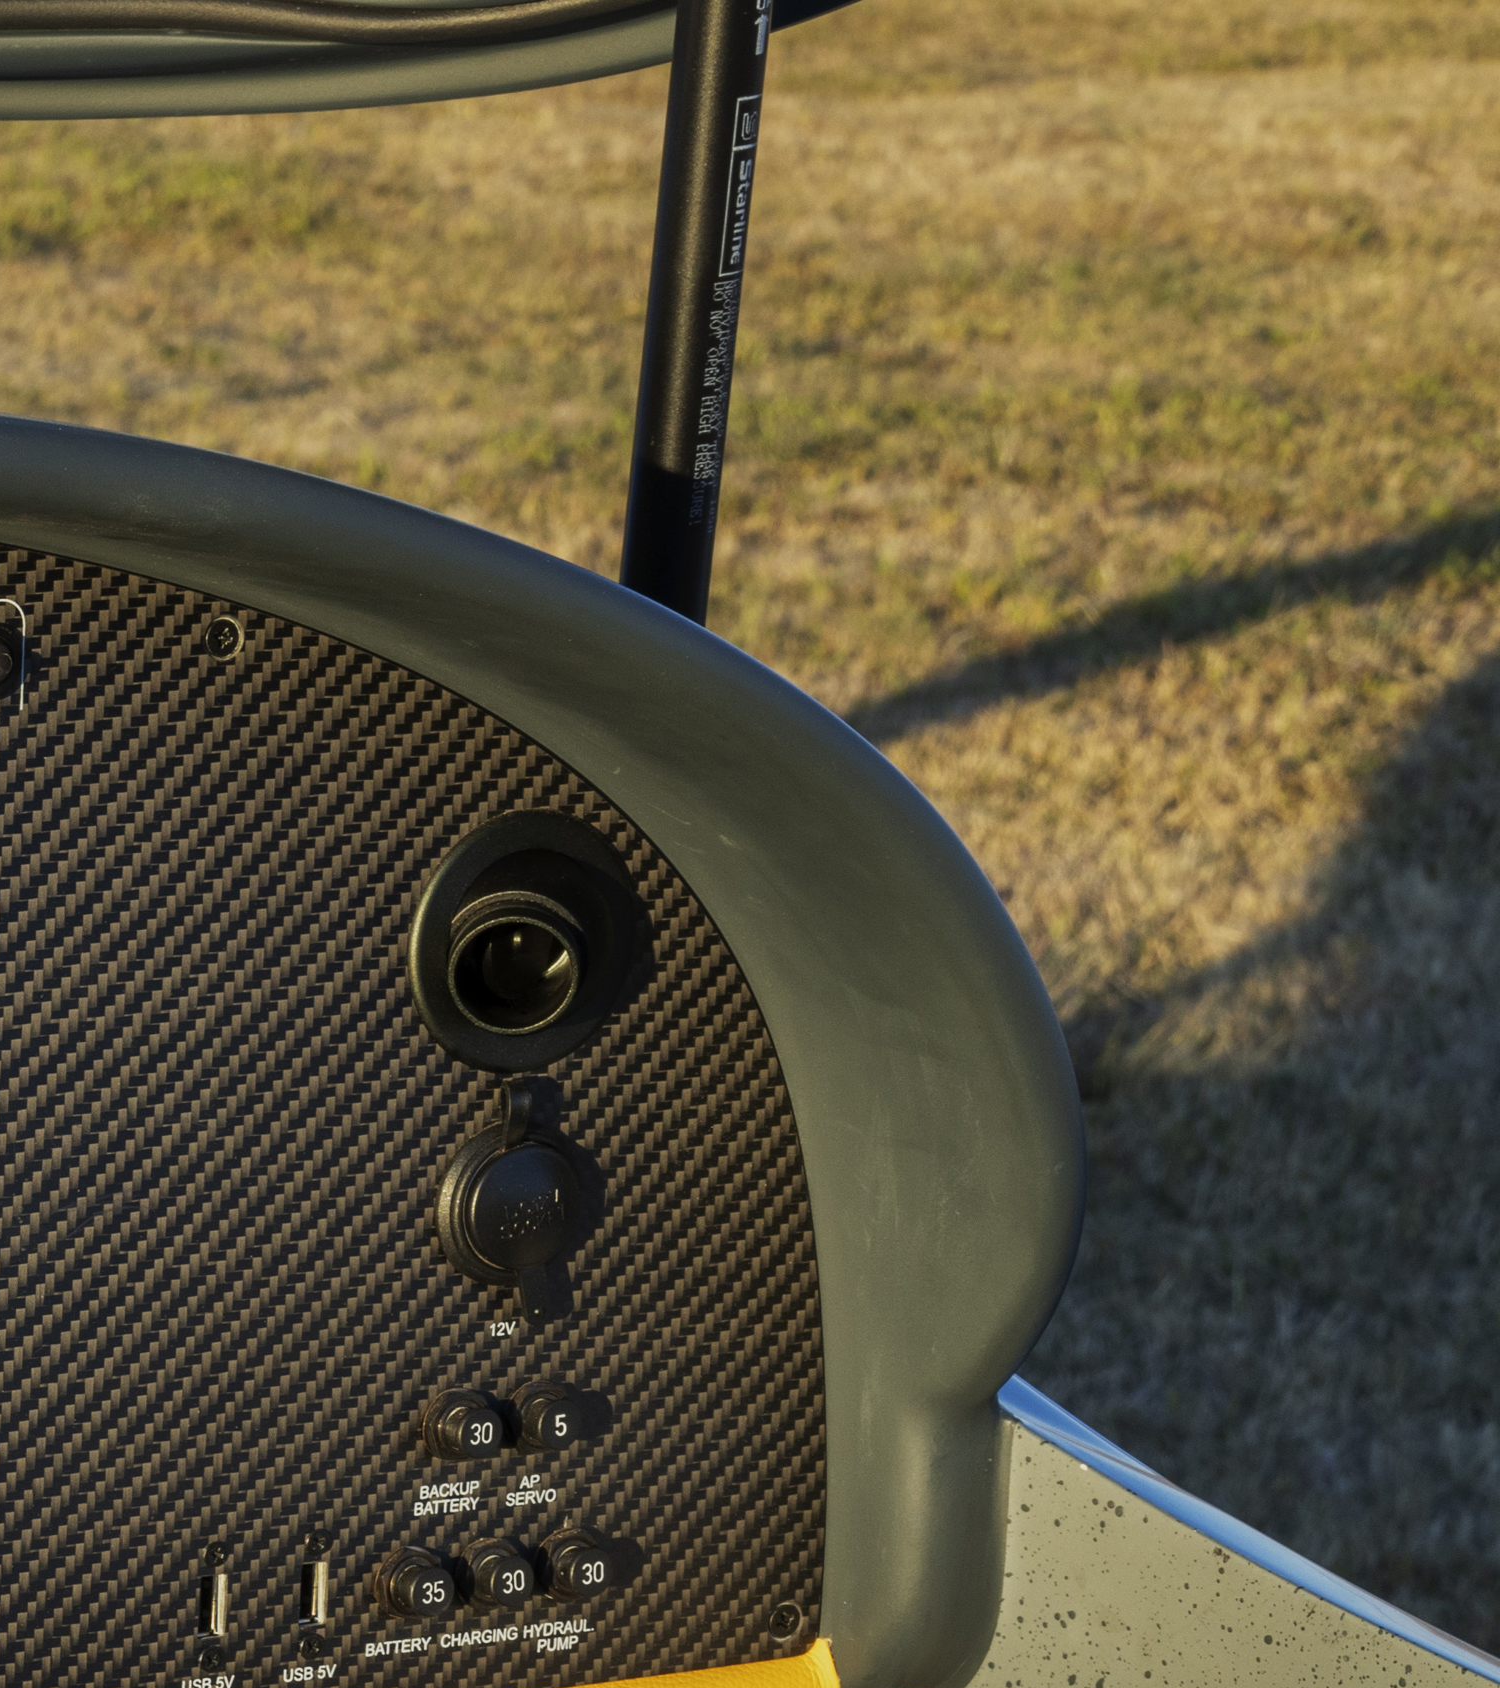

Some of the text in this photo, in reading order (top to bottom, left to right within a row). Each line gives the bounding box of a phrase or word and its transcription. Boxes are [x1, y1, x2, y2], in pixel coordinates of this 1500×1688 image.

[729, 159, 753, 265] Starline
[489, 1322, 517, 1337] 12V
[419, 1481, 480, 1500] BACKUP
[413, 1497, 480, 1517] BATTERY
[364, 1619, 595, 1658] BATTERY CHARGING HYDRAUL.
[536, 1635, 579, 1653] PUMP
